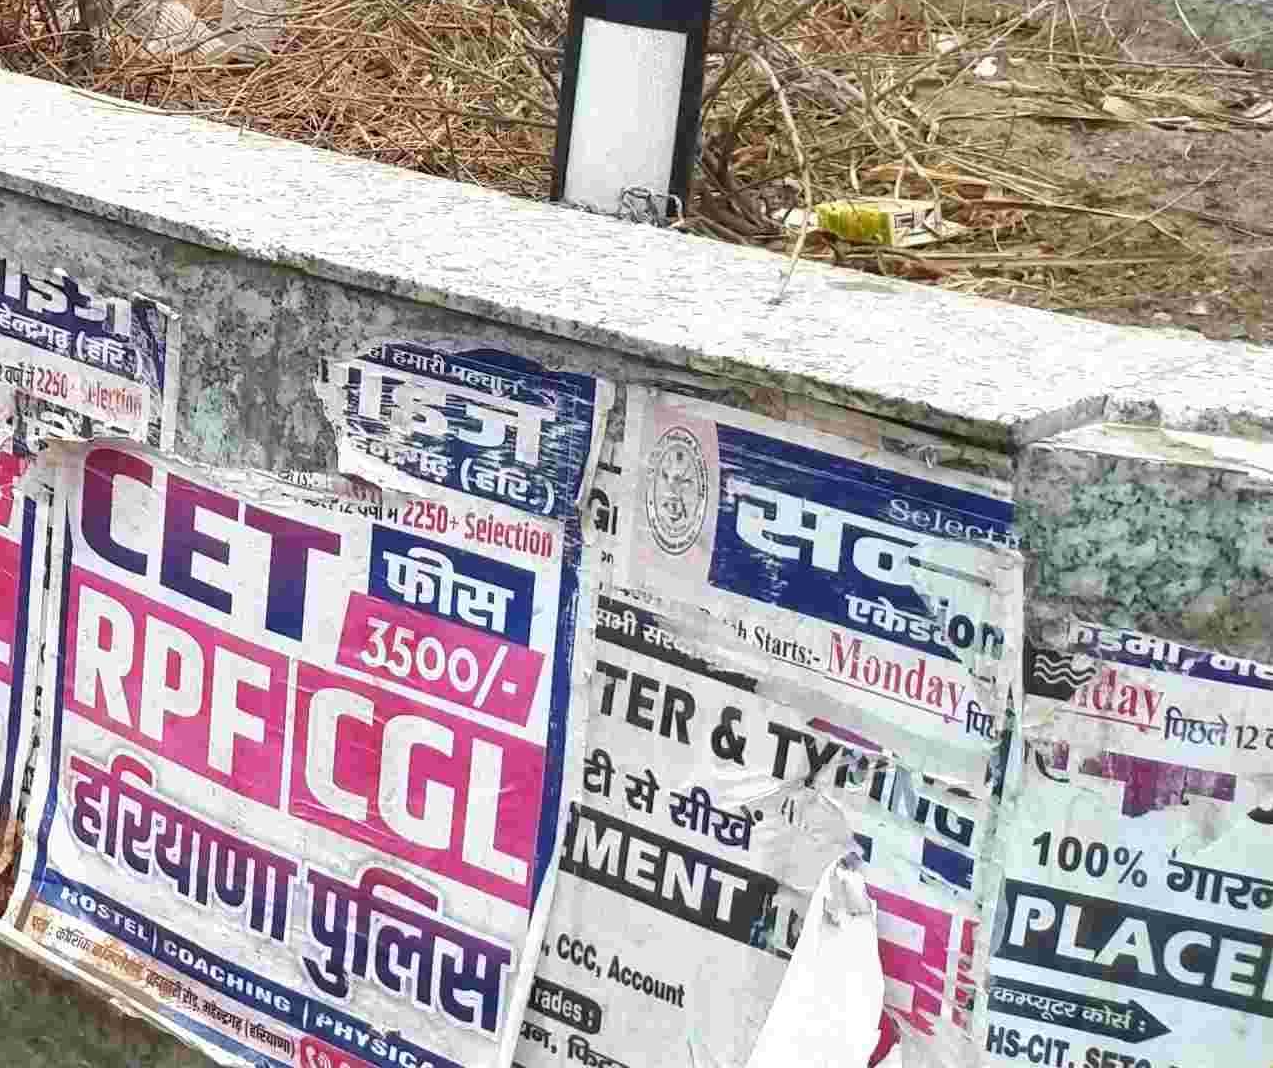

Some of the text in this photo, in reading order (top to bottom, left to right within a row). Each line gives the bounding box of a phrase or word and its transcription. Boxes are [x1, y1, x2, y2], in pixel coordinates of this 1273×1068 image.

[392, 348, 448, 376] हमारी
[80, 448, 343, 644] CET
[402, 499, 460, 534] 2250+
[463, 513, 553, 559] Selection
[383, 547, 515, 631] फीस
[359, 615, 517, 709] 3500/-
[828, 631, 965, 725] Monday
[73, 584, 272, 781] RPF
[305, 686, 530, 885] CGL
[594, 659, 750, 767] TER &
[1164, 706, 1259, 750] पिछले 12
[625, 769, 661, 815] से
[669, 787, 765, 851] सीखें
[68, 751, 301, 942] हरियाणा
[302, 864, 513, 1033] पुलिस
[1032, 831, 1149, 888] 100%
[59, 887, 293, 1014] HOSTEL COACHING
[557, 933, 685, 1008] CCC, Account
[1009, 893, 1273, 1006] PLACE
[534, 987, 583, 1022] rades
[993, 987, 1133, 1029] कम्प्यूटर कोर्स
